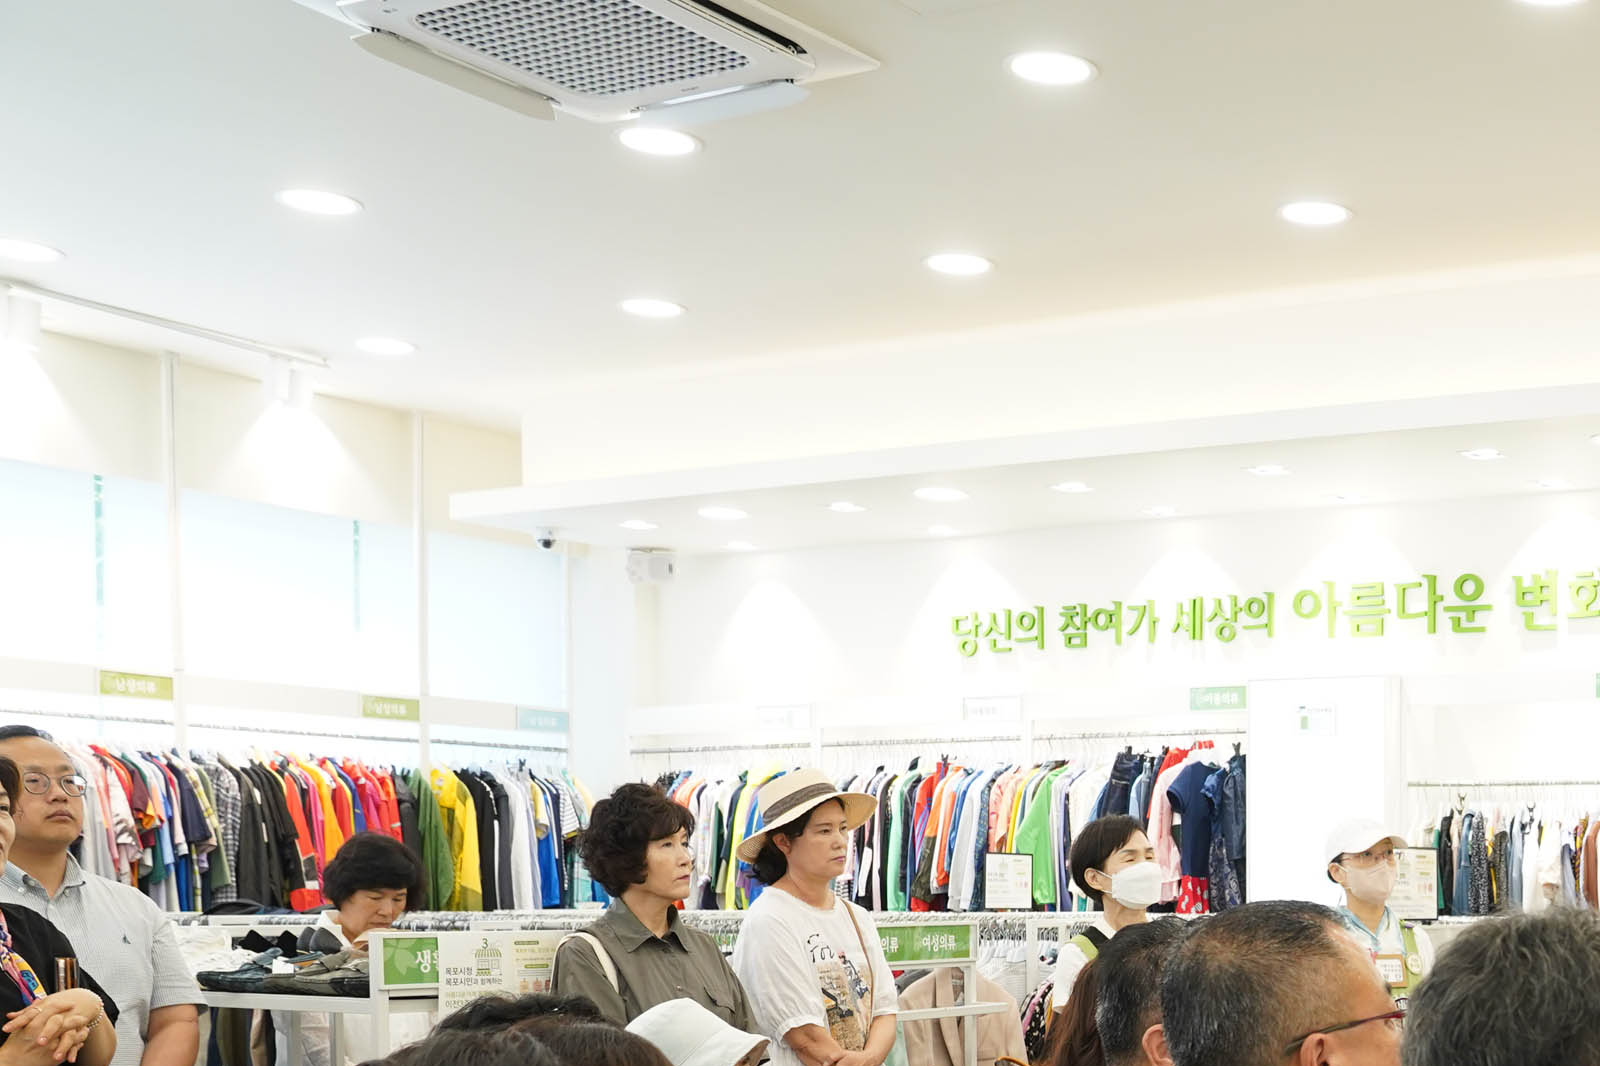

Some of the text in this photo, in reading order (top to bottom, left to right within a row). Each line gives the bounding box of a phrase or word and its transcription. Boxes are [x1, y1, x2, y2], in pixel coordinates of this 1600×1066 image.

[952, 605, 1046, 657] 당신의
[1058, 599, 1161, 650] 참여가
[1171, 591, 1276, 644] 세상의
[1292, 572, 1494, 640] 아름다운
[922, 934, 956, 952] 여성의류
